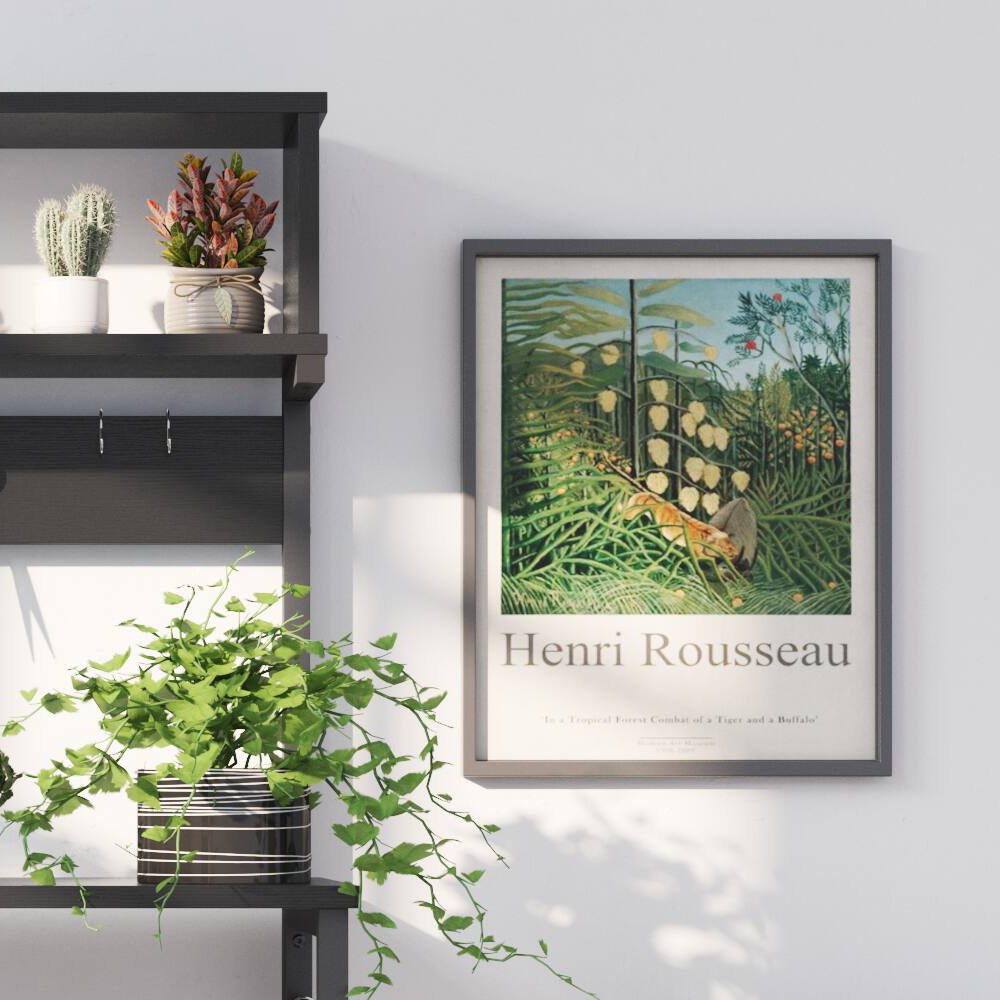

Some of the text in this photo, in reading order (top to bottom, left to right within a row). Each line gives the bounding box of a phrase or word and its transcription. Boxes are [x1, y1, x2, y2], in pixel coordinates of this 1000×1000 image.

[501, 632, 851, 667] Henri Rousseau
[570, 714, 611, 726] Tropical
[616, 714, 646, 724] Forest
[650, 714, 689, 724] Combat
[692, 714, 705, 724] of
[717, 714, 742, 726] Tiger
[747, 714, 765, 724] and
